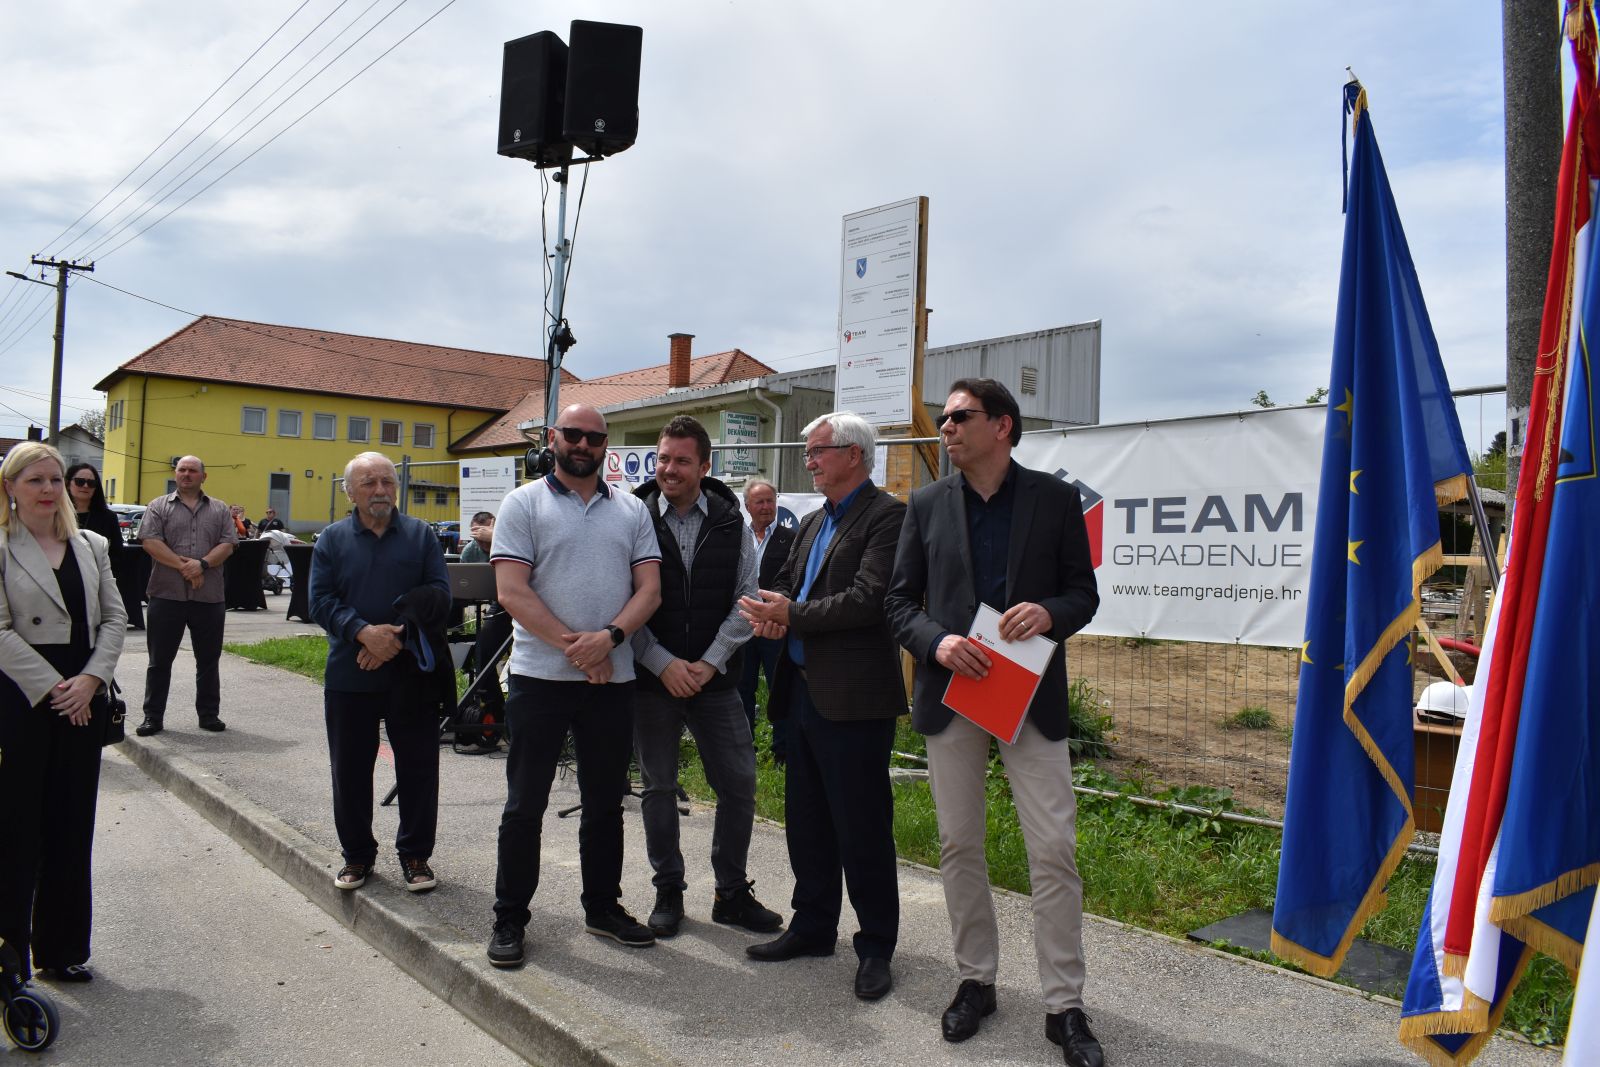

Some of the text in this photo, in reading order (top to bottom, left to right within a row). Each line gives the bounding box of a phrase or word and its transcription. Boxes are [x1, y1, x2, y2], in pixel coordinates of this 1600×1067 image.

[1114, 492, 1303, 534] TEAM
[1113, 544, 1302, 567] GRAĐENJE
[1112, 583, 1302, 603] www.teamgradjenje.hr
